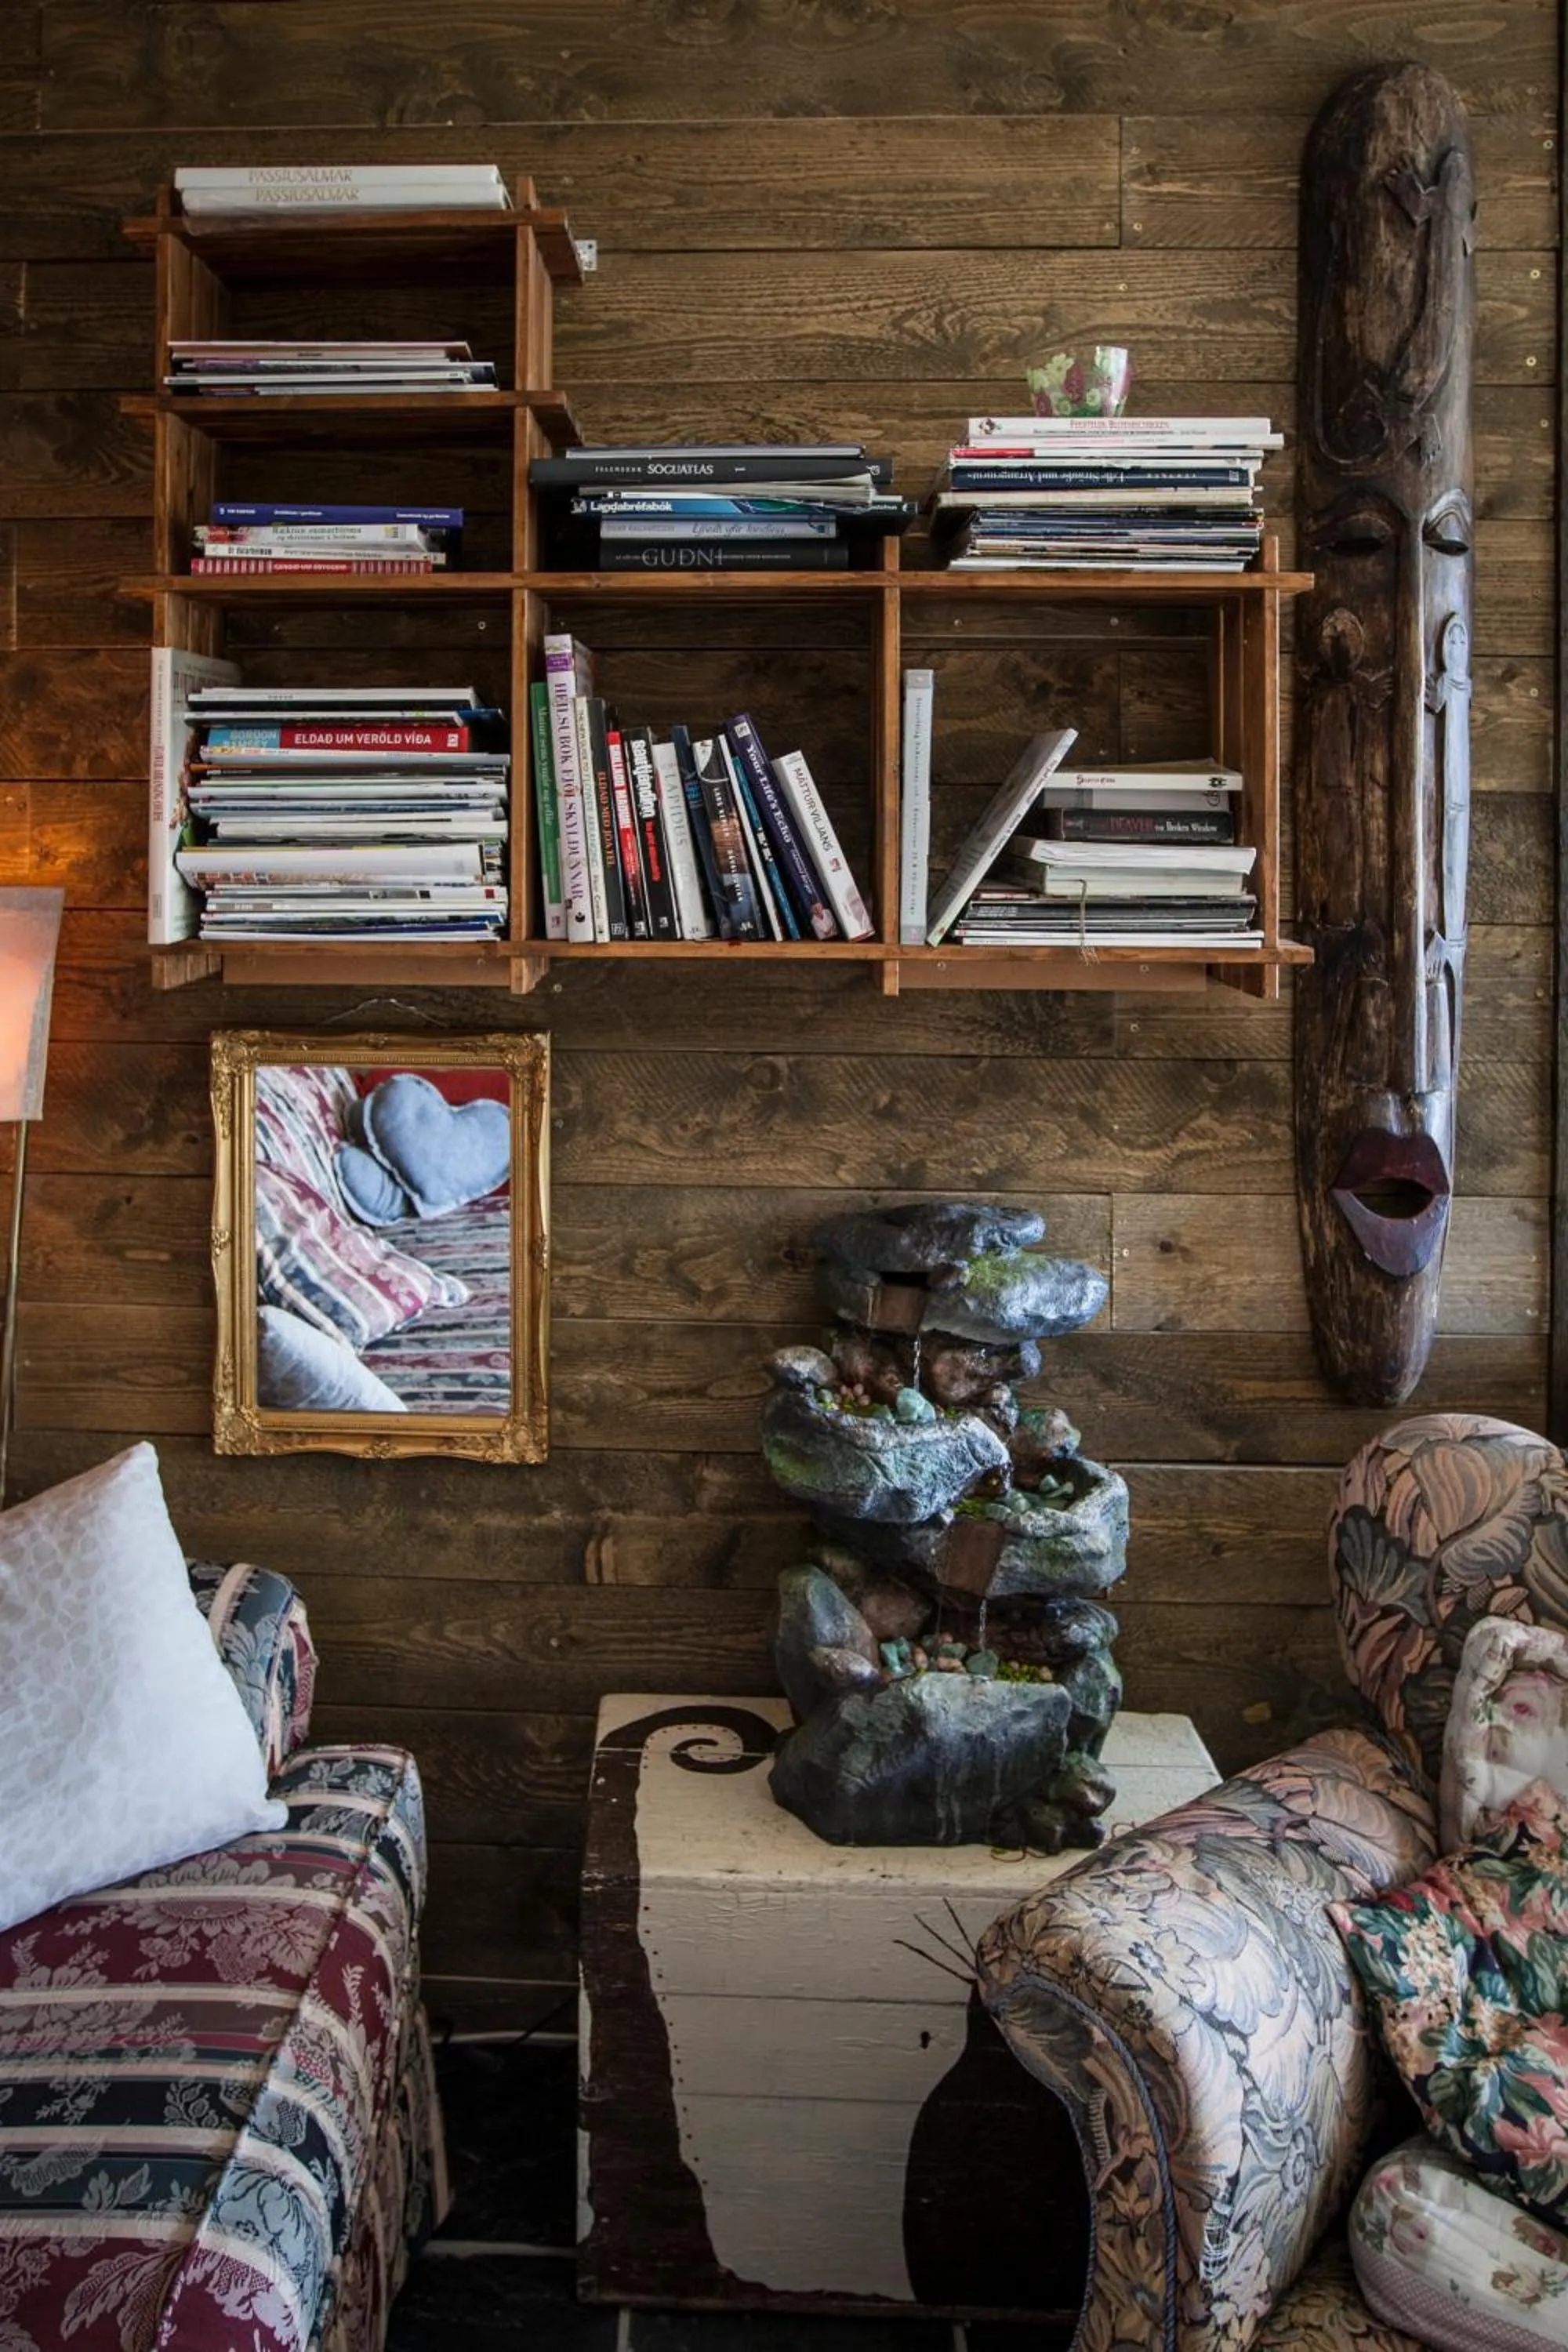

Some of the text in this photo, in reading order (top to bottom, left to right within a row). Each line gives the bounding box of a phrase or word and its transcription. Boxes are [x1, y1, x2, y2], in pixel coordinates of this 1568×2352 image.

[230, 730, 277, 739] GORDON
[294, 732, 431, 744] ELDAÐ UM VERÖLD VÍÐA
[746, 744, 764, 775] Your
[760, 777, 779, 810] Life's
[772, 809, 793, 844] Echo
